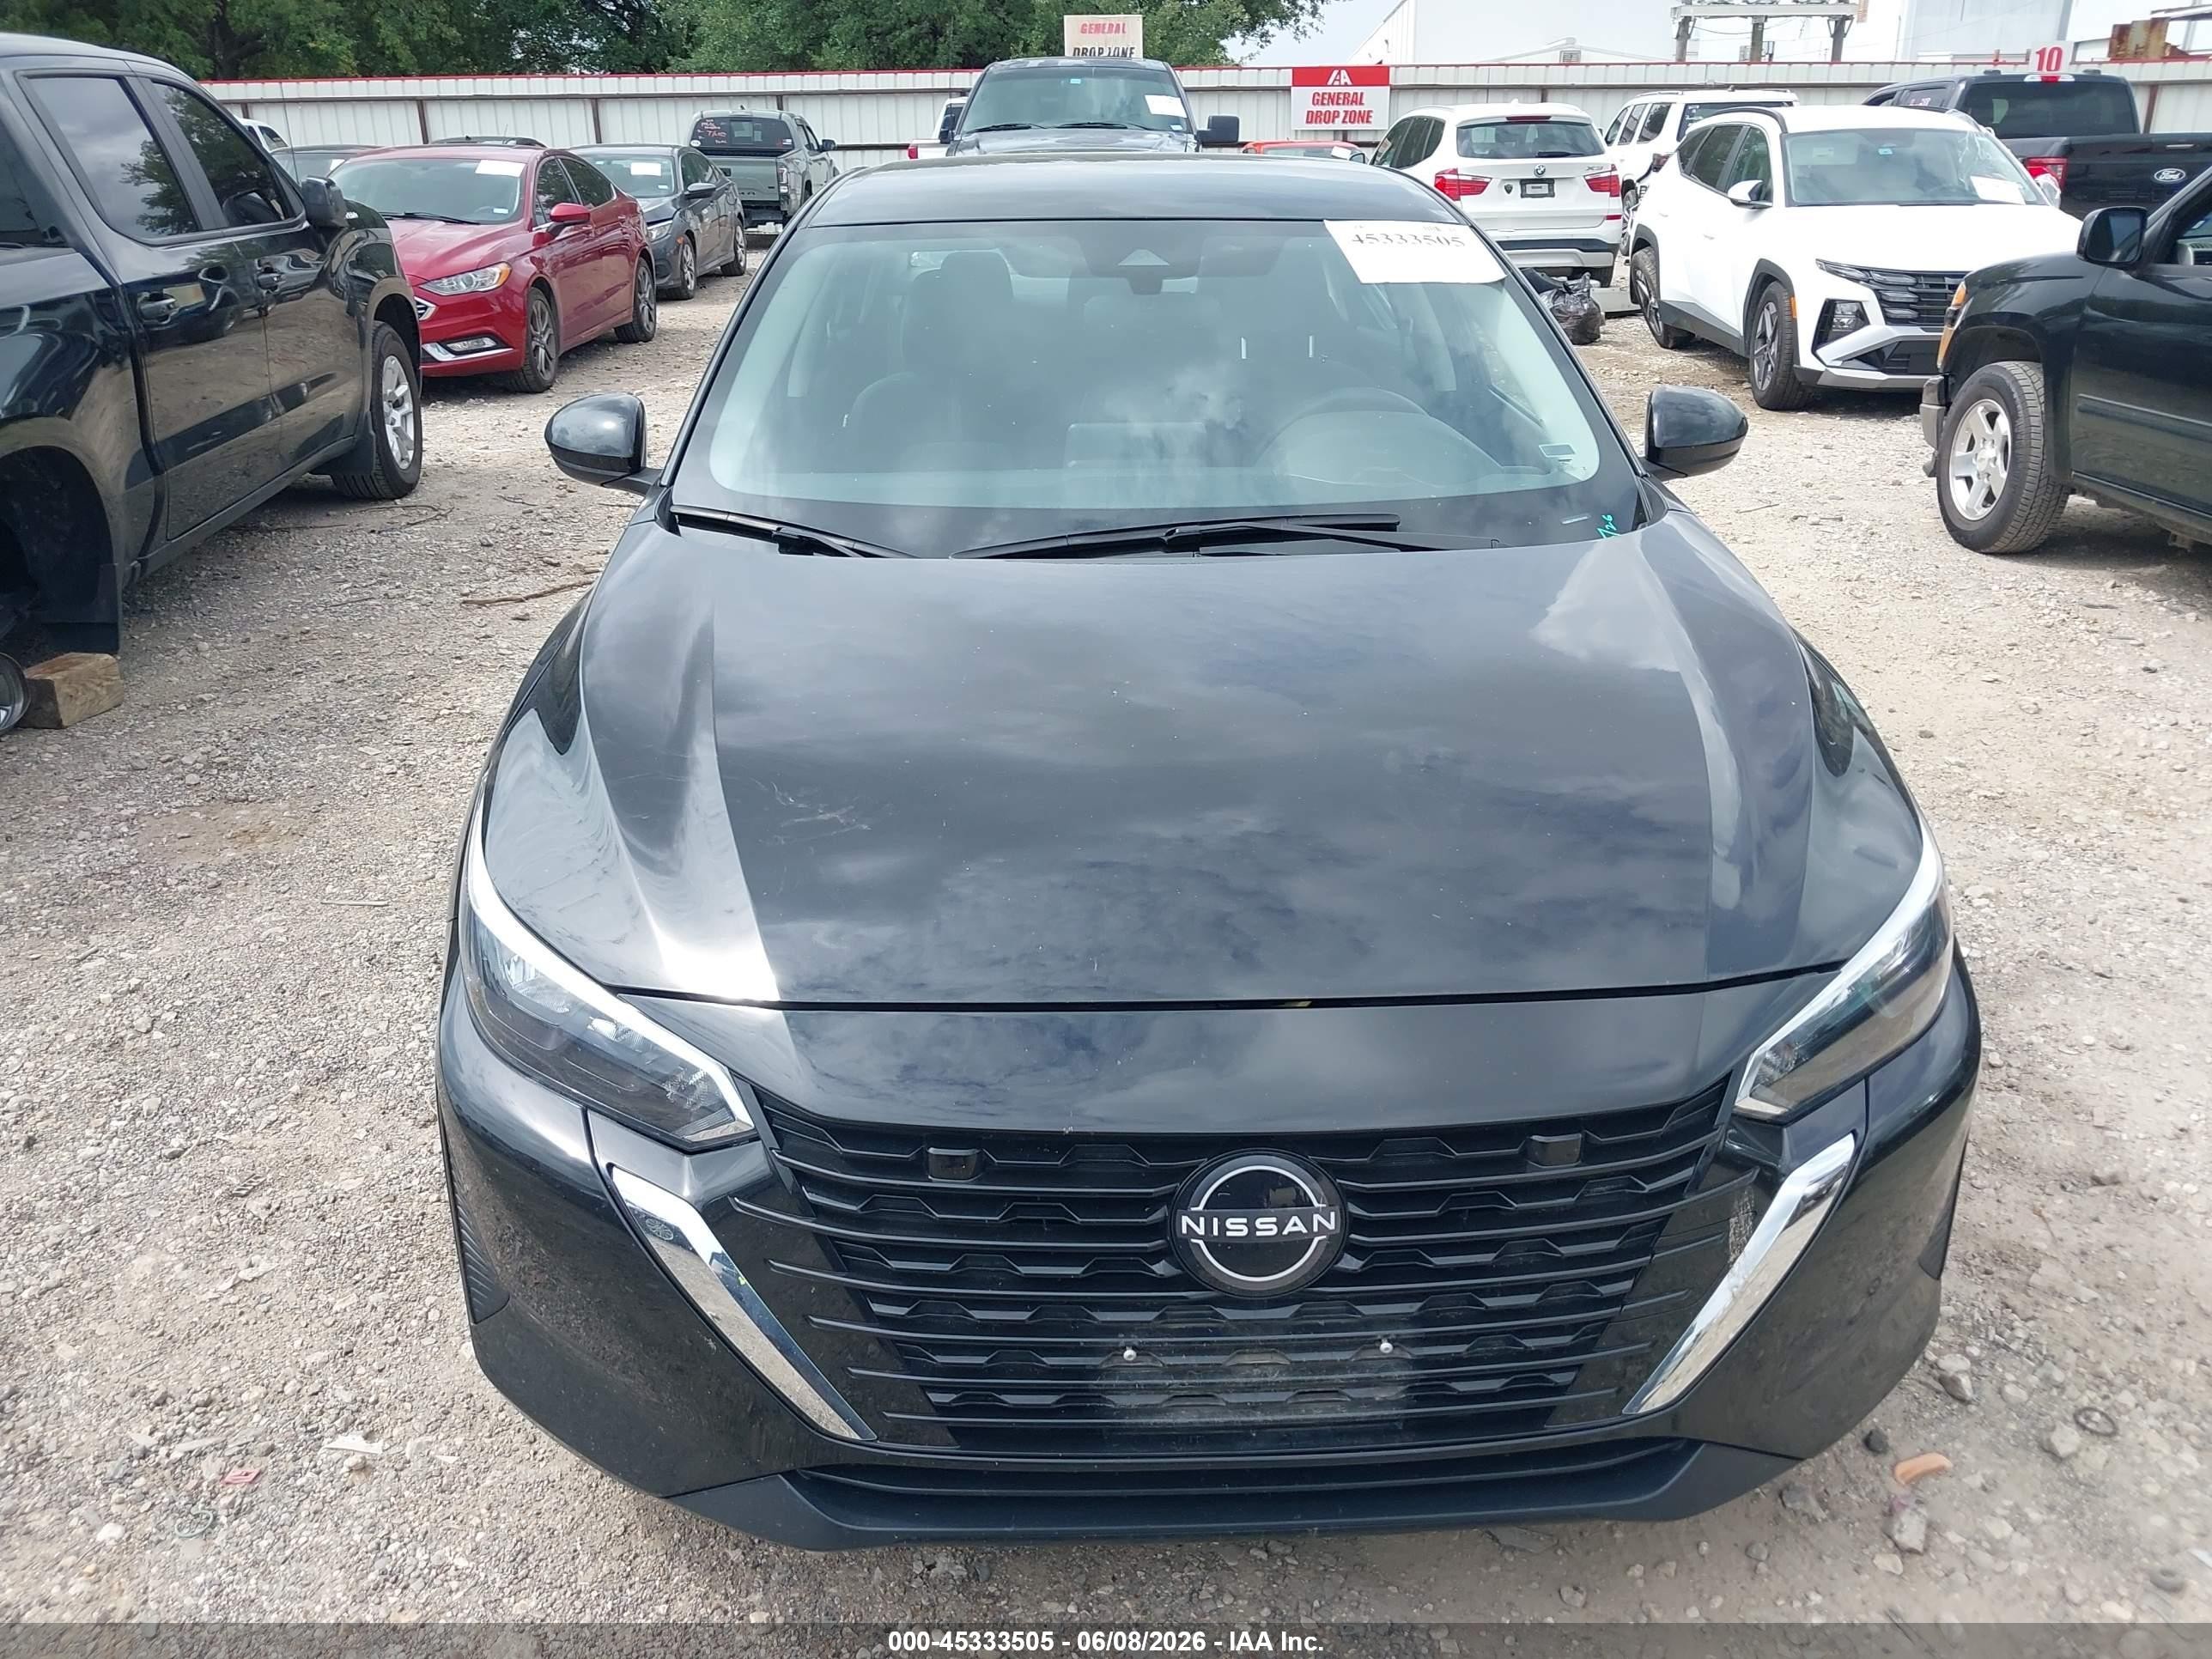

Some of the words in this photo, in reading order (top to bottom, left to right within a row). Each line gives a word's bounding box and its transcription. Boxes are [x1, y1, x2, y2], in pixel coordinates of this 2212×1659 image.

[1079, 21, 1127, 34] GENERAL
[1072, 46, 1104, 57] DROP
[2035, 46, 2063, 72] 10
[1311, 91, 1365, 106] GENERAL
[1305, 110, 1340, 125] DROP
[1341, 110, 1374, 125] ZONE
[1181, 1211, 1336, 1237] NISSAN
